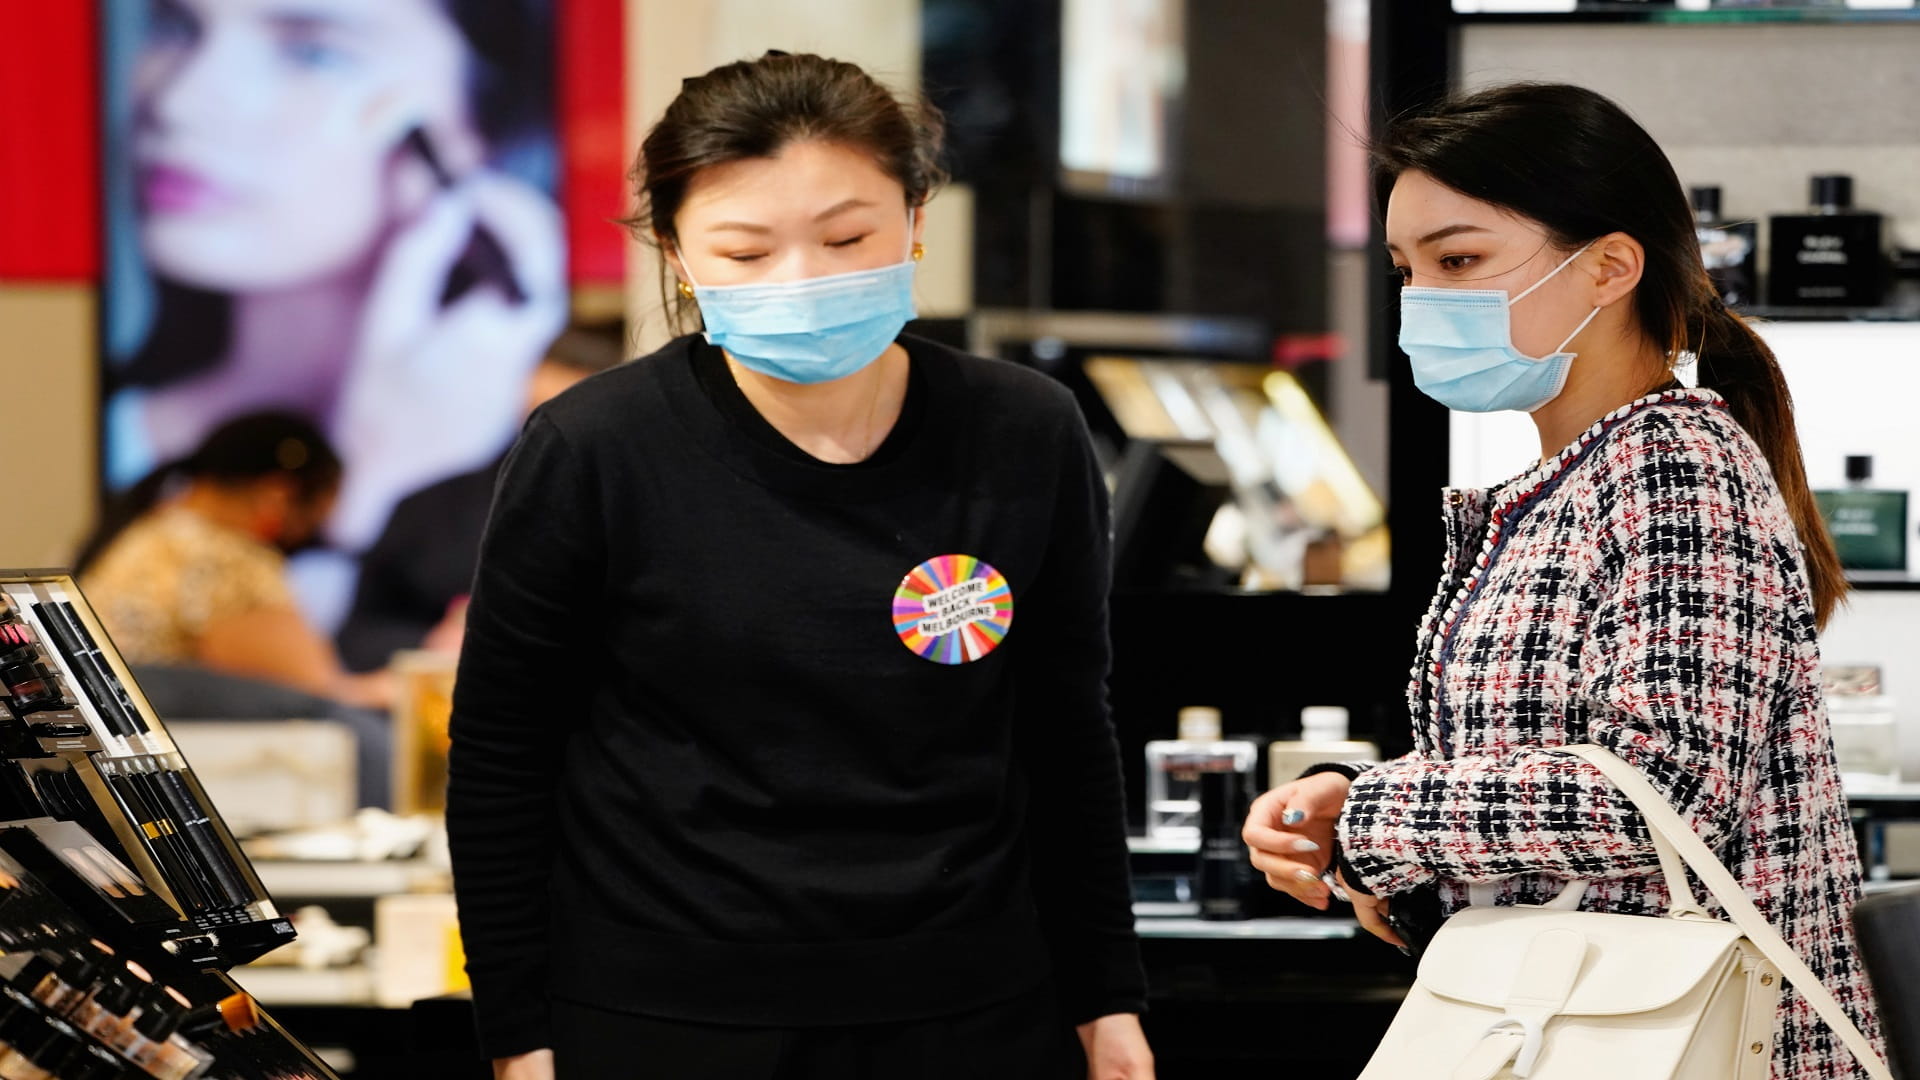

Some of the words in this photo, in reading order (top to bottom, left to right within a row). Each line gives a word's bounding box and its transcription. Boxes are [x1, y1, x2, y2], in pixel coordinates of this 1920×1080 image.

[927, 582, 983, 607] WELCOME
[922, 606, 991, 632] MELBOURNE
[941, 598, 970, 617] BACK
